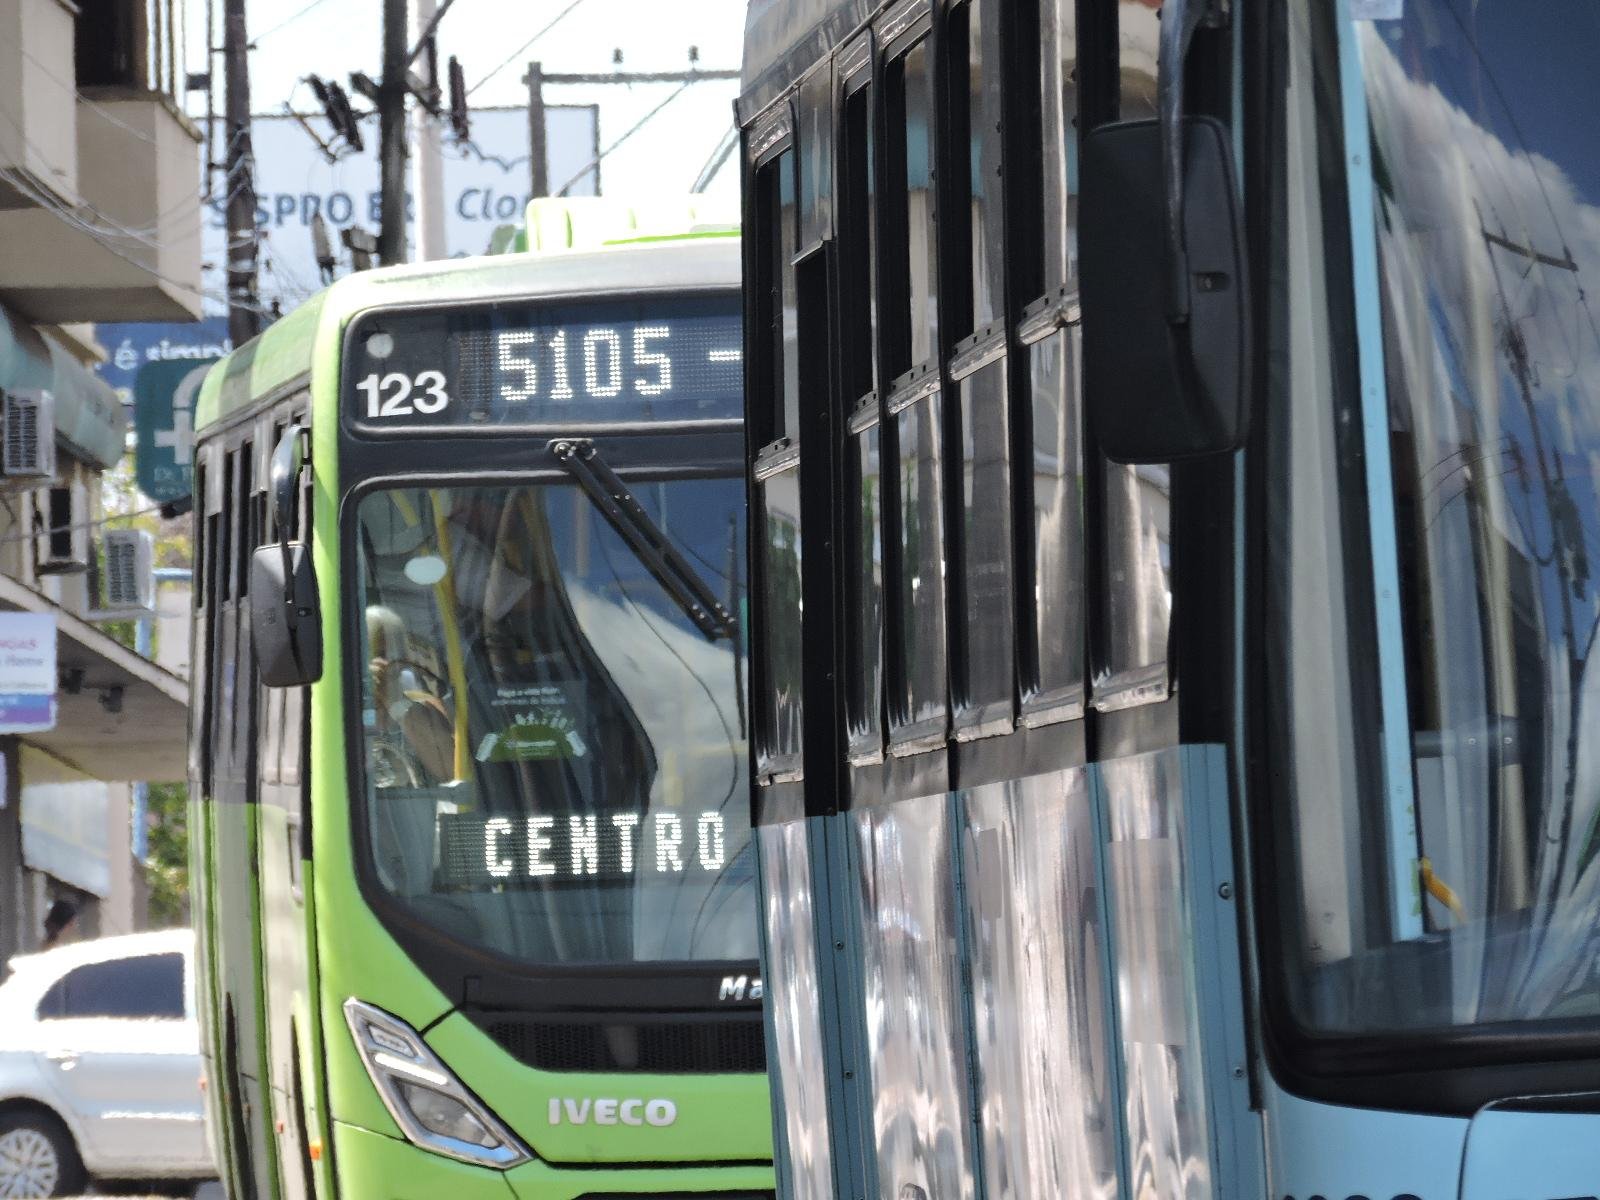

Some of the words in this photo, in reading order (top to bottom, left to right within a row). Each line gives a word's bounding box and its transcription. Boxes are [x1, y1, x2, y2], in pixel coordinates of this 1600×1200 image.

[209, 192, 353, 228] SSPRO
[457, 188, 527, 222] Clo
[498, 326, 671, 401] 5105
[356, 370, 449, 418] 123
[485, 811, 725, 877] CENTRO
[548, 1098, 677, 1127] IVECO
